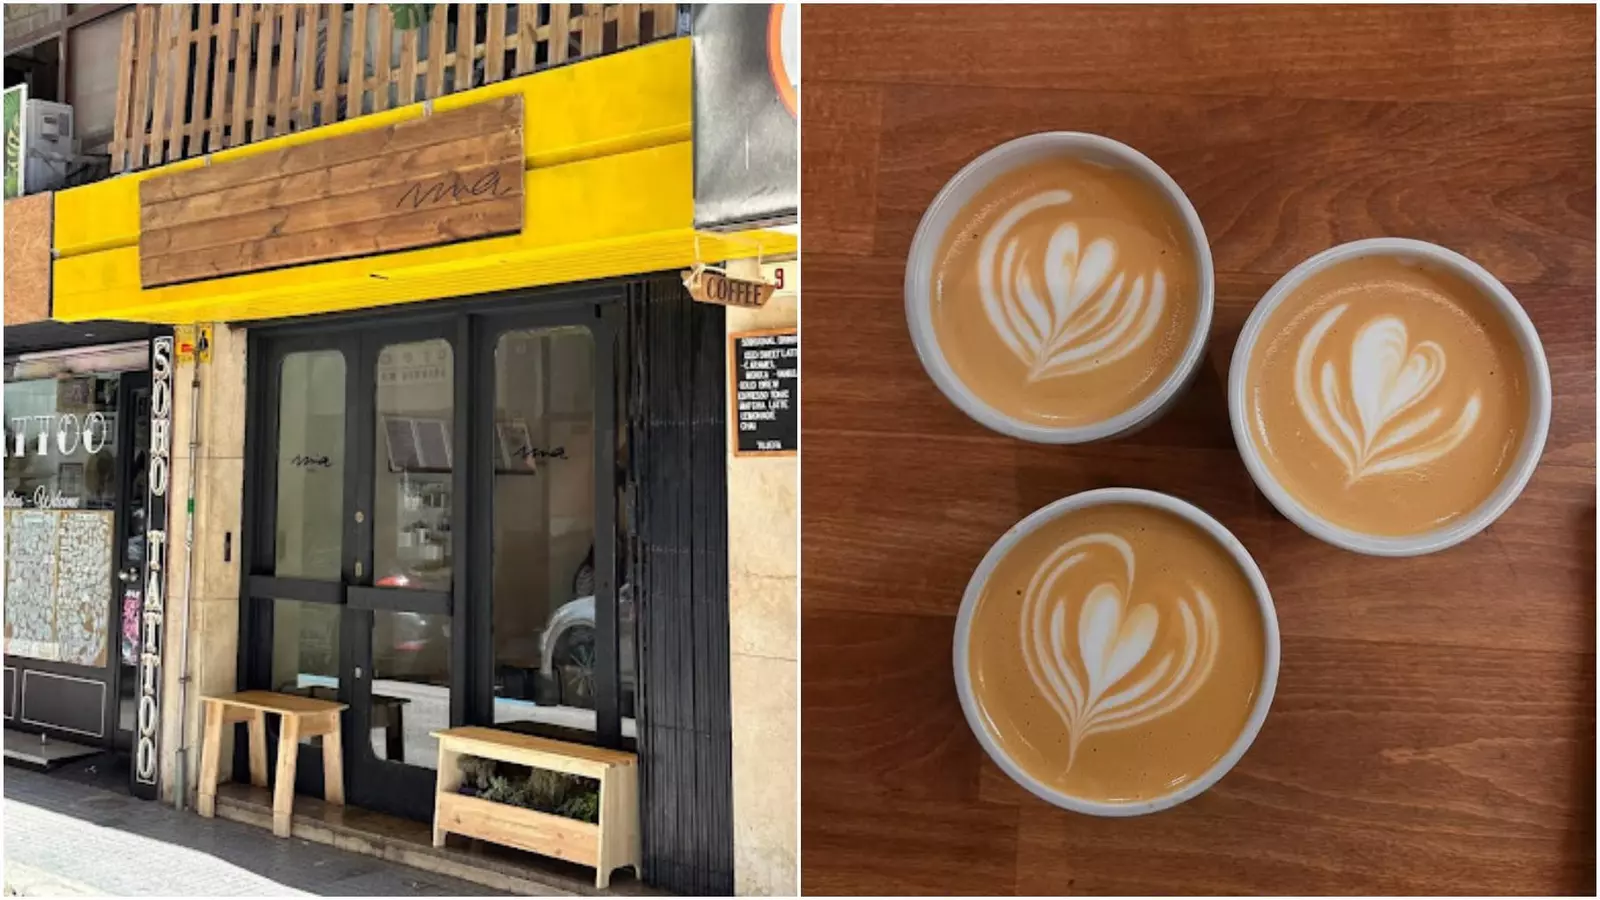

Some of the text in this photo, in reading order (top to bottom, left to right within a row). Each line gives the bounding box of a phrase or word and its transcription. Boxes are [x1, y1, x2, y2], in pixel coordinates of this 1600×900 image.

[774, 267, 784, 290] 9
[706, 277, 762, 306] COFFEE
[738, 389, 790, 400] ESPRESSO TONIC
[739, 399, 789, 411] MATCHA LATTE
[150, 336, 171, 497] SOHO
[740, 411, 776, 421] LEMONADE
[137, 529, 167, 779] TATTOO
